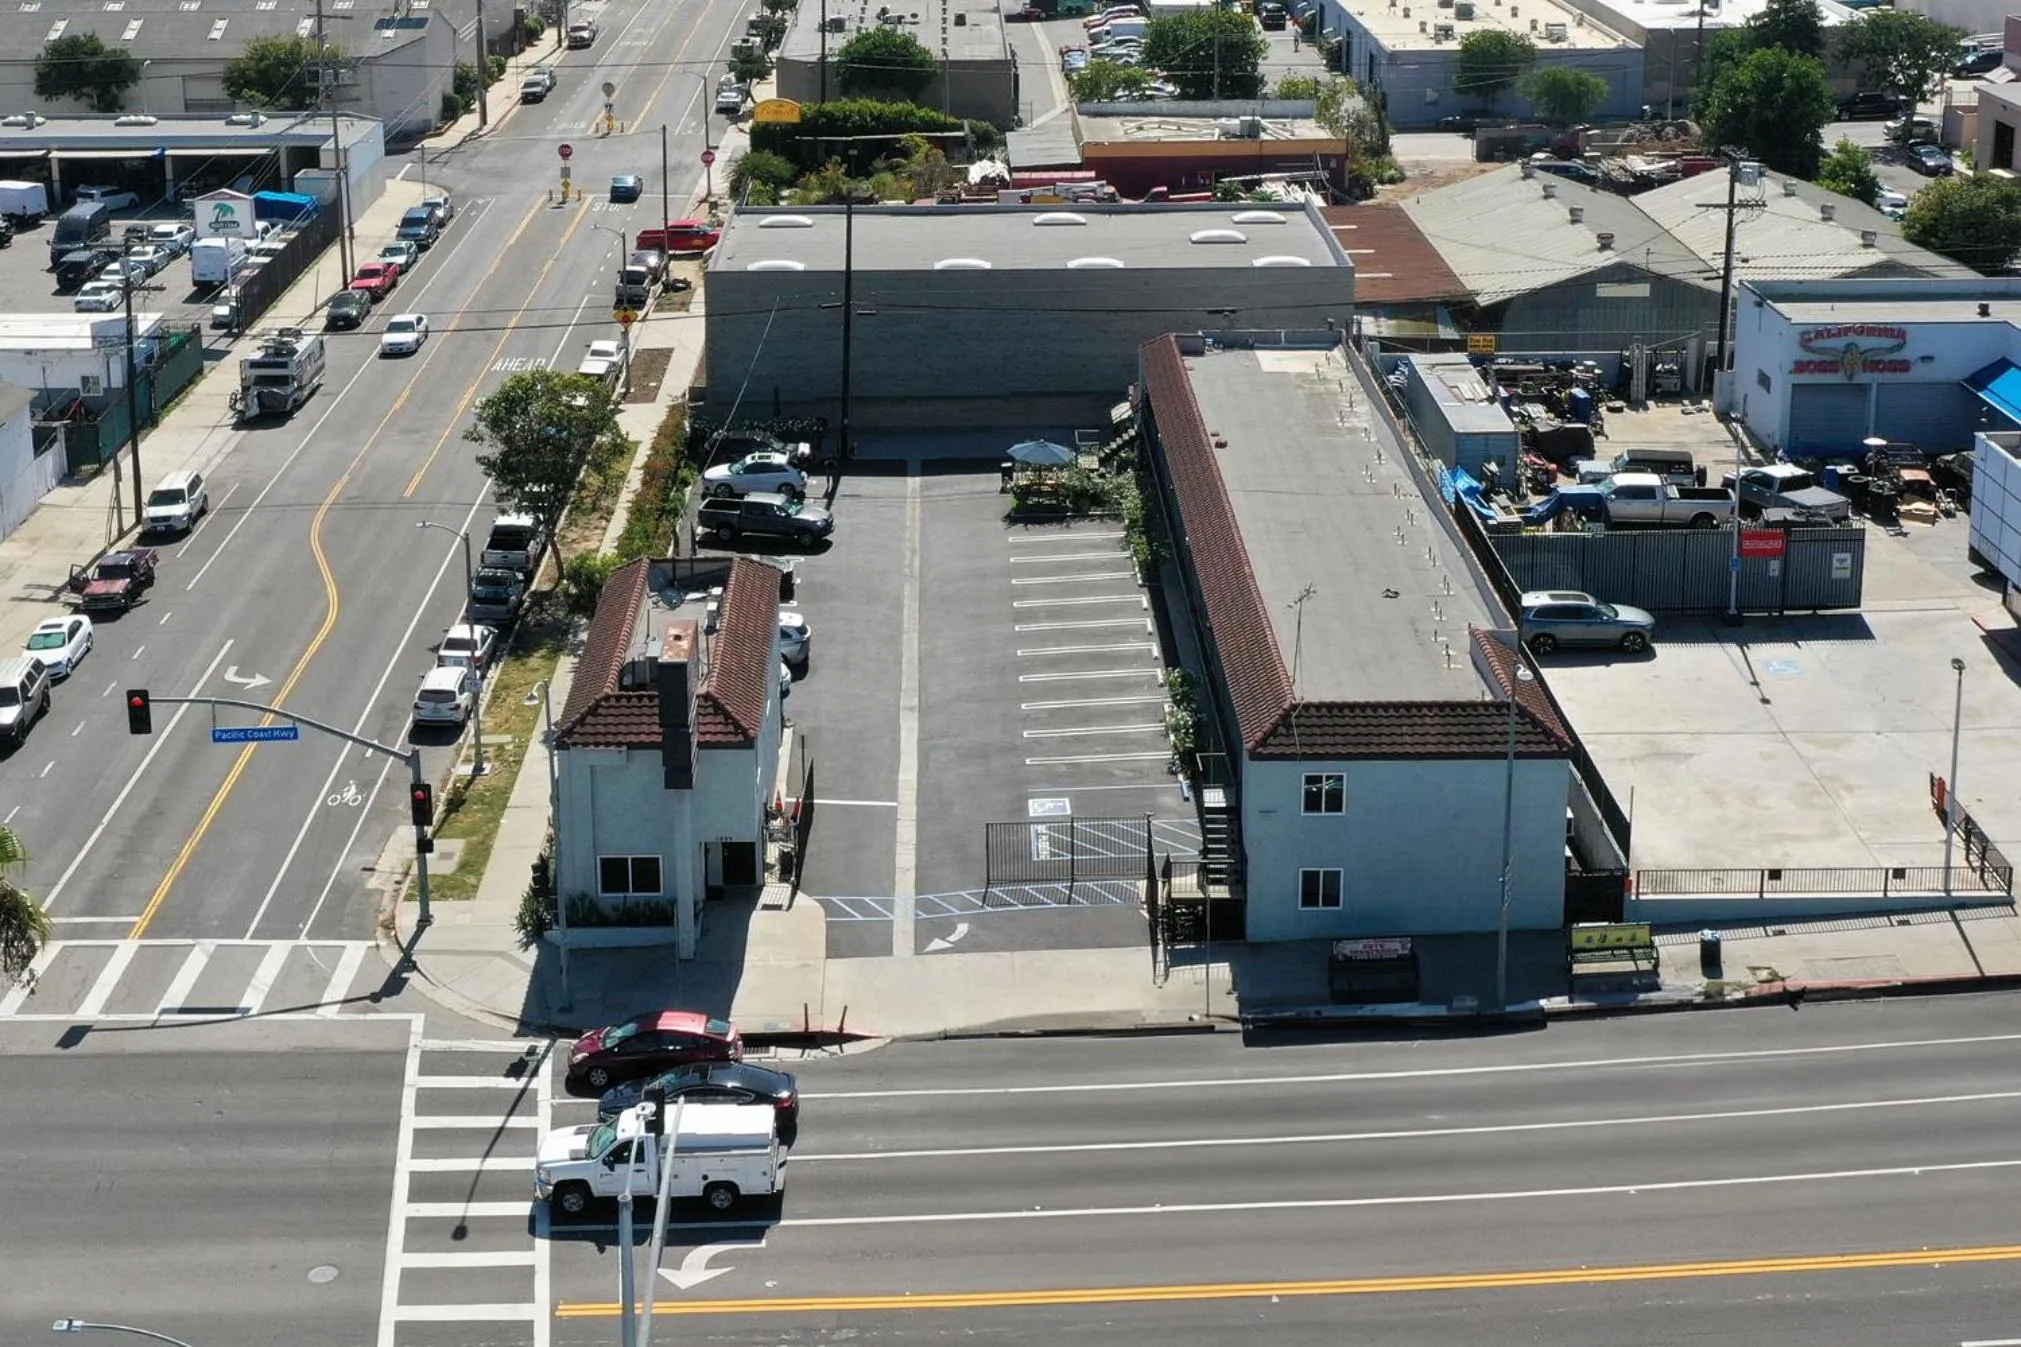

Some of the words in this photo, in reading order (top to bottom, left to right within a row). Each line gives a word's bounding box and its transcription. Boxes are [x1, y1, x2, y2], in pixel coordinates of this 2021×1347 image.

[1799, 325, 1907, 343] CALIFORNIA
[215, 730, 245, 739] Pacific
[247, 729, 272, 738] Coast
[273, 728, 295, 738] Hwy
